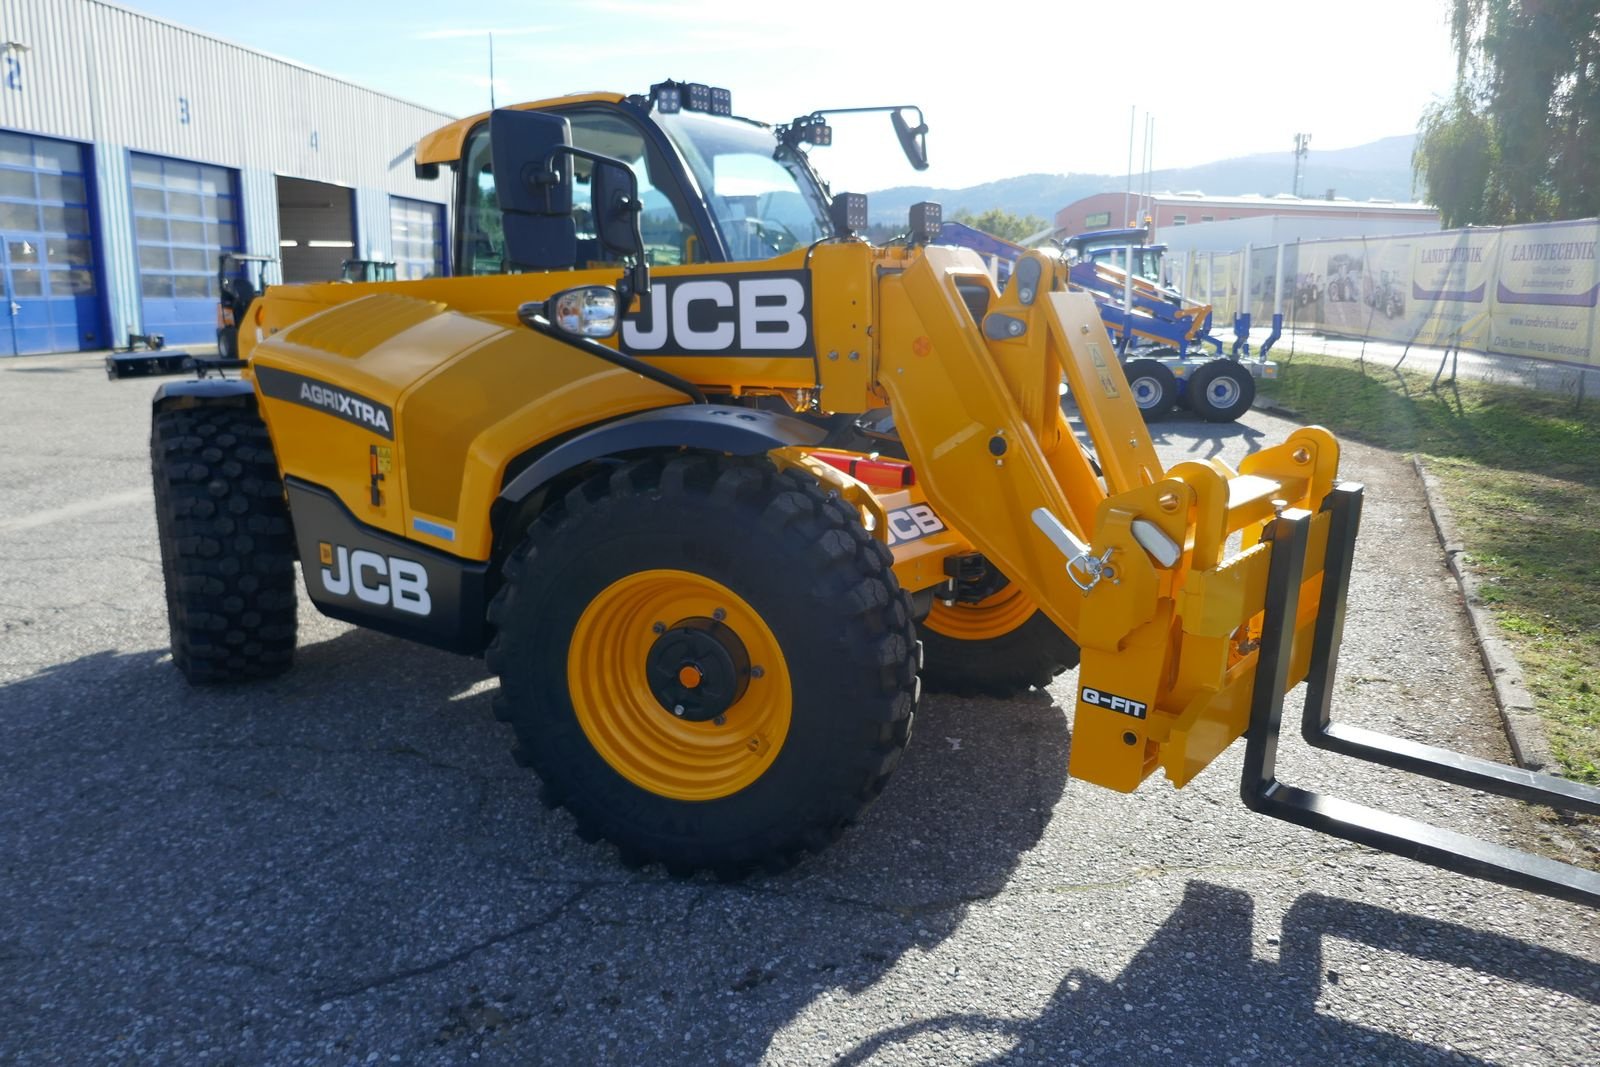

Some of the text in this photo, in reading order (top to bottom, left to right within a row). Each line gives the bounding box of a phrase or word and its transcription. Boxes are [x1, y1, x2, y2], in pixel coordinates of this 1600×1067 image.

[7, 57, 22, 91] 2
[179, 97, 190, 124] 3
[310, 130, 319, 152] 4
[1511, 241, 1597, 261] LANDTECHNIK
[622, 278, 807, 350] JCB
[301, 382, 390, 432] AGRIXTRA
[321, 546, 431, 616] JCB
[1082, 688, 1146, 716] Q-FIT
